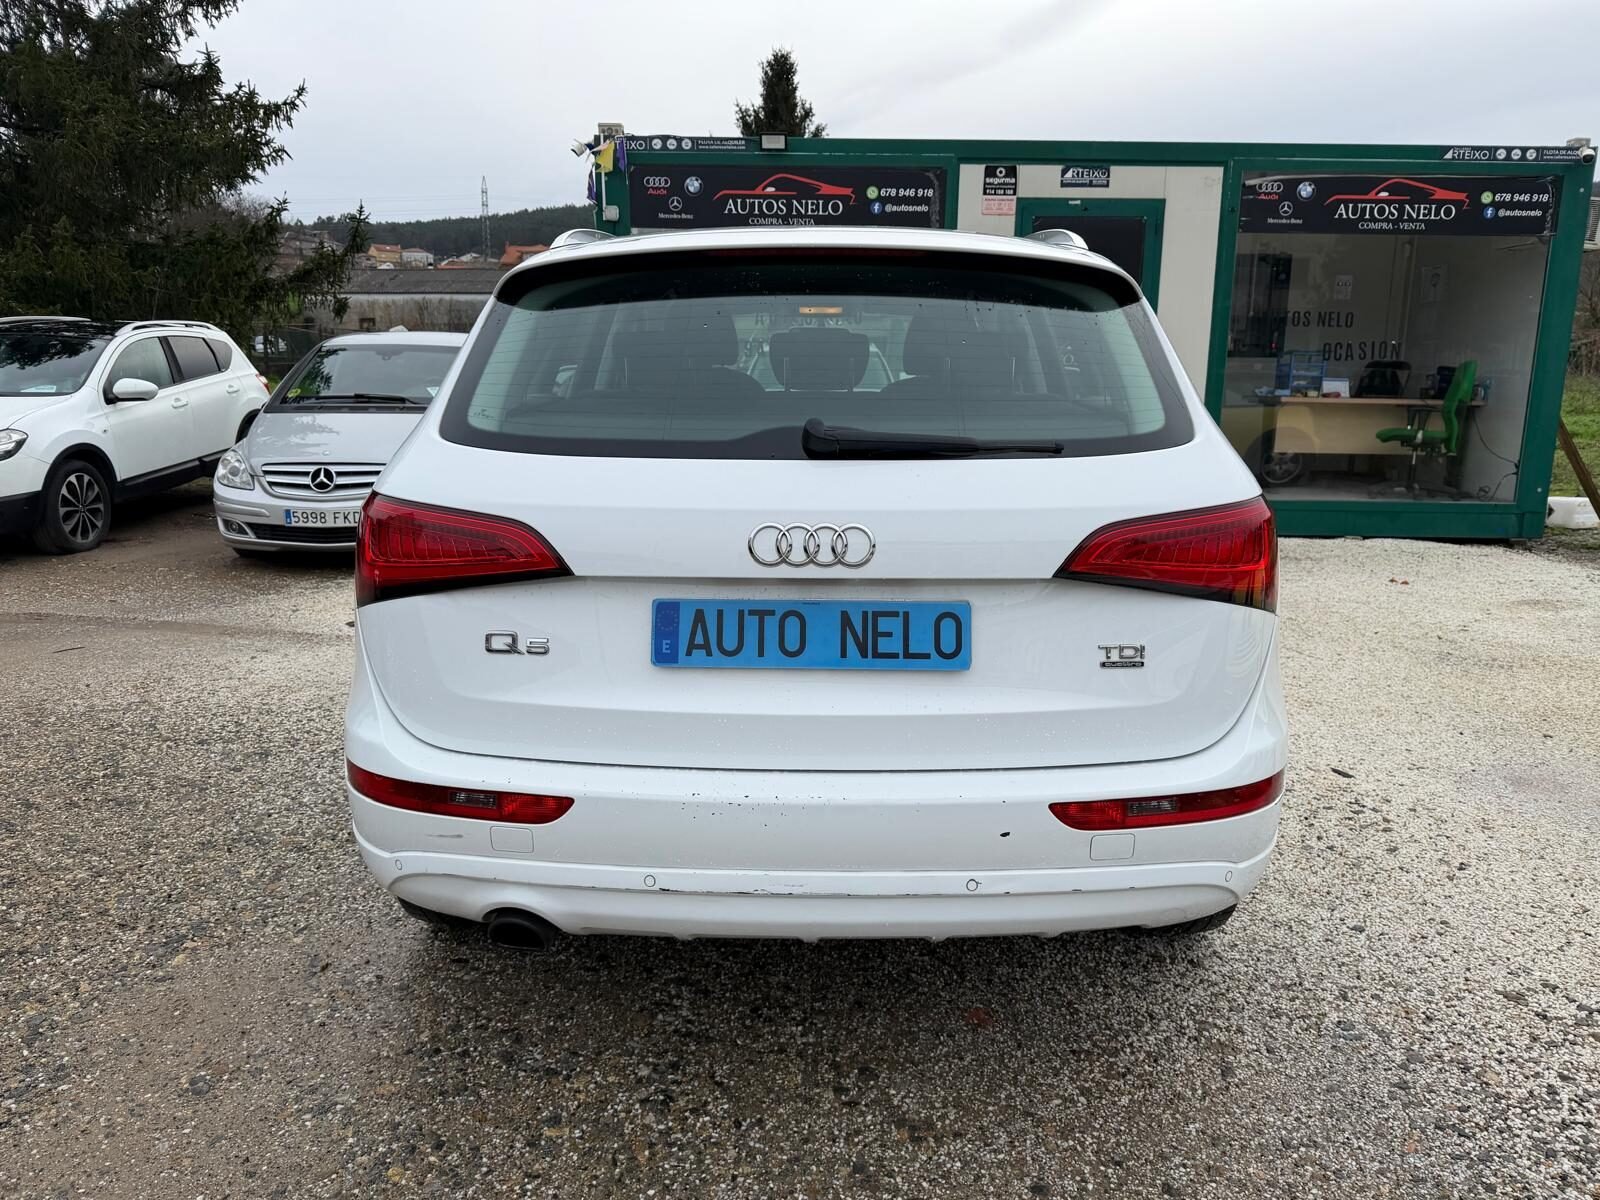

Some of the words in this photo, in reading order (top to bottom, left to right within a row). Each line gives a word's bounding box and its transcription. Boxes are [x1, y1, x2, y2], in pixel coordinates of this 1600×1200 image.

[880, 188, 896, 197] 678
[898, 188, 915, 198] 946
[917, 188, 934, 198] 918
[1494, 193, 1511, 202] 678
[1512, 193, 1530, 202] 946
[1532, 193, 1549, 202] 918
[723, 198, 787, 215] AUTOS
[791, 199, 844, 216] NELO
[884, 203, 929, 213] @autosnelo
[1334, 203, 1399, 219] AUTOS
[1402, 204, 1456, 220] NELO
[1497, 207, 1543, 217] @autosnelo
[748, 217, 783, 225] COMPRA
[788, 218, 815, 226] VENTA
[1358, 221, 1393, 230] COMPRA
[1400, 222, 1426, 231] VENTA
[1288, 310, 1312, 327] OS
[1316, 311, 1355, 328] NELO
[292, 511, 327, 524] 5998
[684, 608, 807, 659] AUTO
[838, 610, 968, 661] NELO
[485, 630, 550, 656] Q5
[663, 640, 674, 654] E
[1098, 643, 1146, 660] TDI
